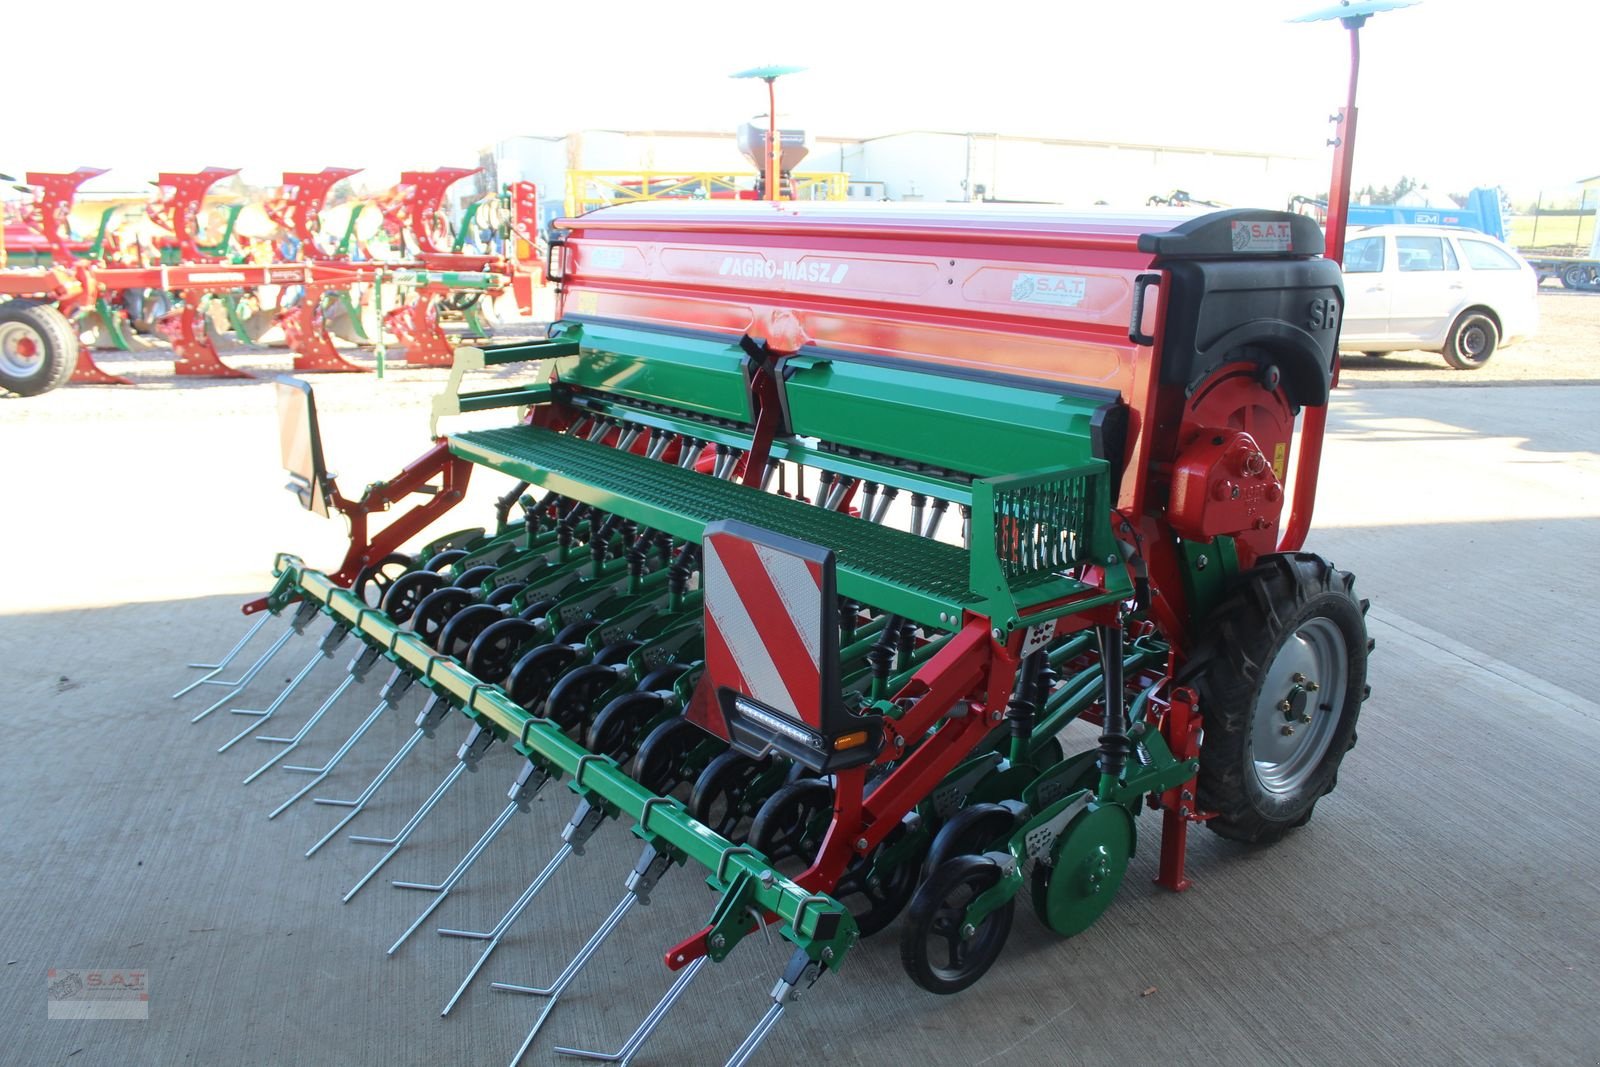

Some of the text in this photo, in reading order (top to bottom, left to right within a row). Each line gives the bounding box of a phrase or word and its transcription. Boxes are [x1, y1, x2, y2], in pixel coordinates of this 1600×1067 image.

[1251, 223, 1289, 238] S.A.T.
[731, 257, 831, 283] AGRO-MASZ
[1036, 278, 1083, 294] S.A.T.
[1309, 298, 1340, 331] SR
